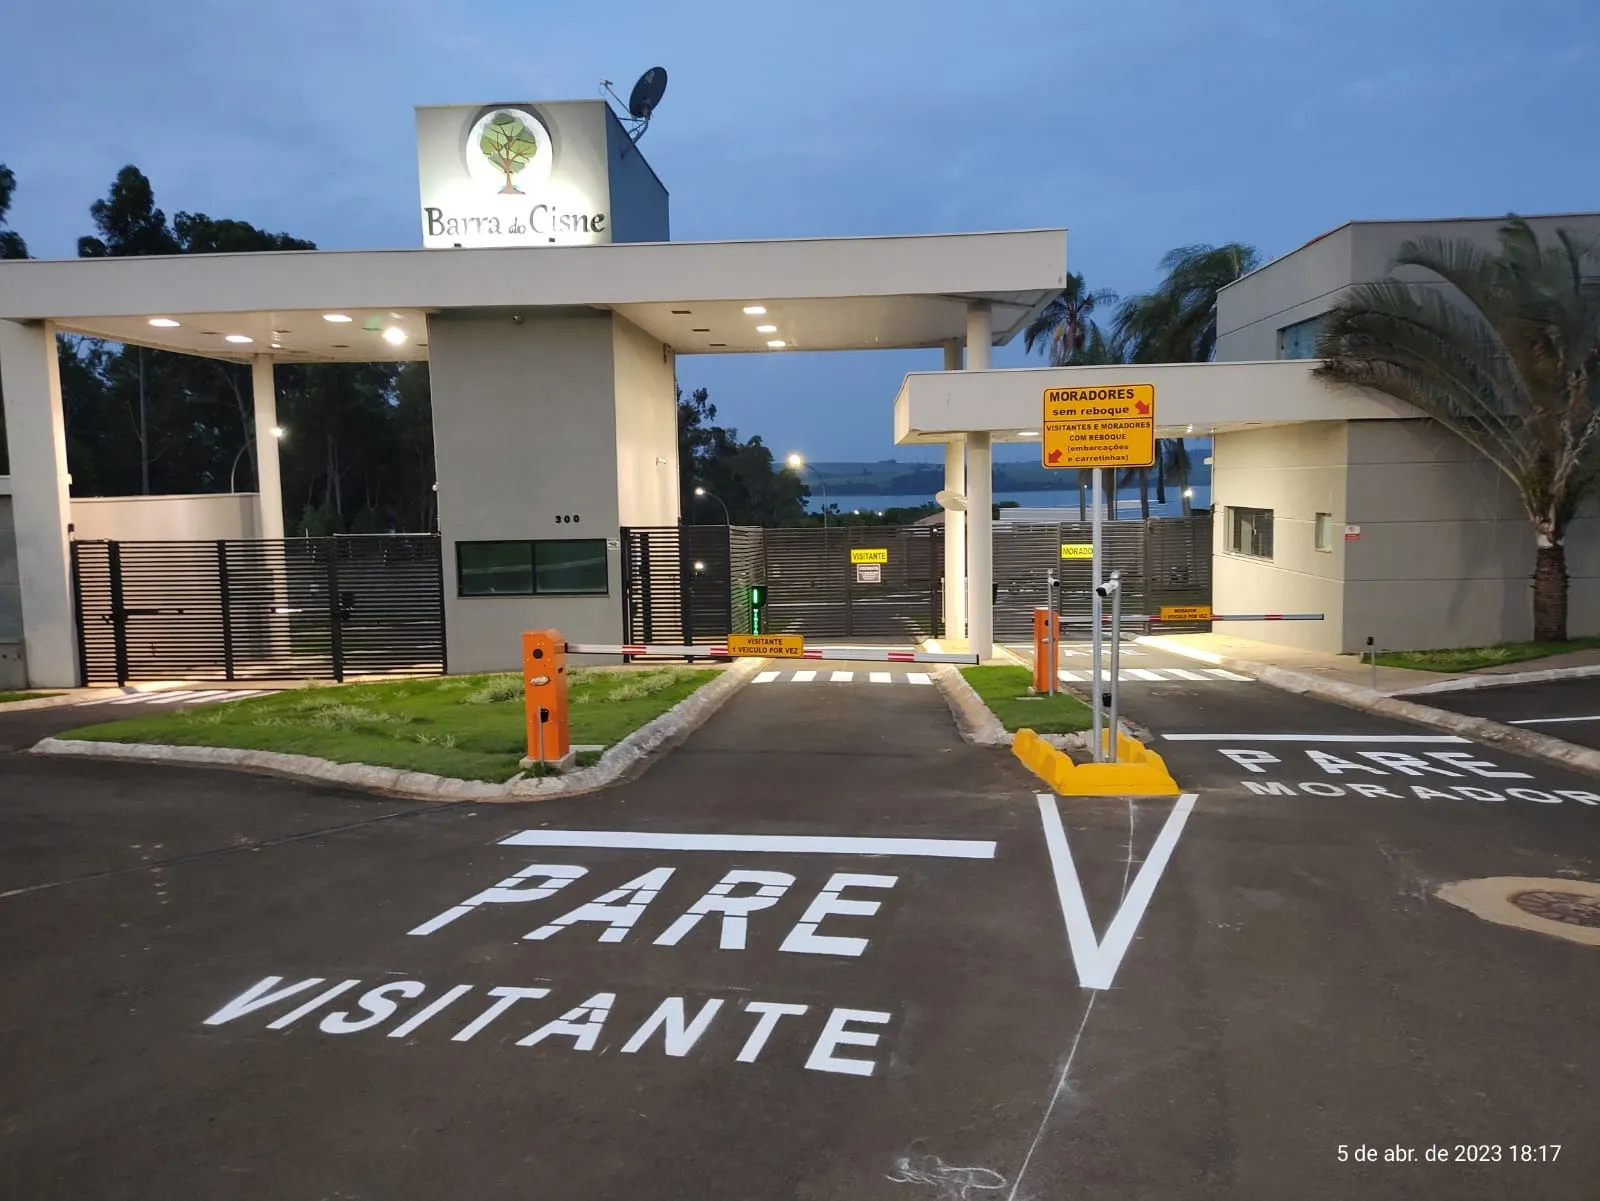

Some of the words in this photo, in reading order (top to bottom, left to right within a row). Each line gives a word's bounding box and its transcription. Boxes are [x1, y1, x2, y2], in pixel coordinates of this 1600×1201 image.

[424, 206, 502, 236] Barra
[508, 217, 526, 235] do
[529, 203, 607, 234] Cisne
[1049, 389, 1134, 402] MORADORES
[1052, 408, 1077, 416] sem
[1080, 406, 1129, 417] reboque
[1046, 423, 1092, 431] VISITANTES
[1101, 422, 1151, 430] MORADORES
[1089, 433, 1127, 441] REBOQUE
[1067, 444, 1129, 453] (embarcações
[1075, 454, 1129, 462] carretinhas)
[555, 515, 580, 524] 300
[1063, 547, 1094, 555] MORADO
[852, 552, 887, 561] VISITANTE
[747, 638, 783, 646] VISITANTE
[1217, 748, 1536, 779] PARE
[1240, 781, 1600, 806] MORADOR
[406, 863, 899, 957] PARE
[202, 975, 892, 1077] VISITANTE
